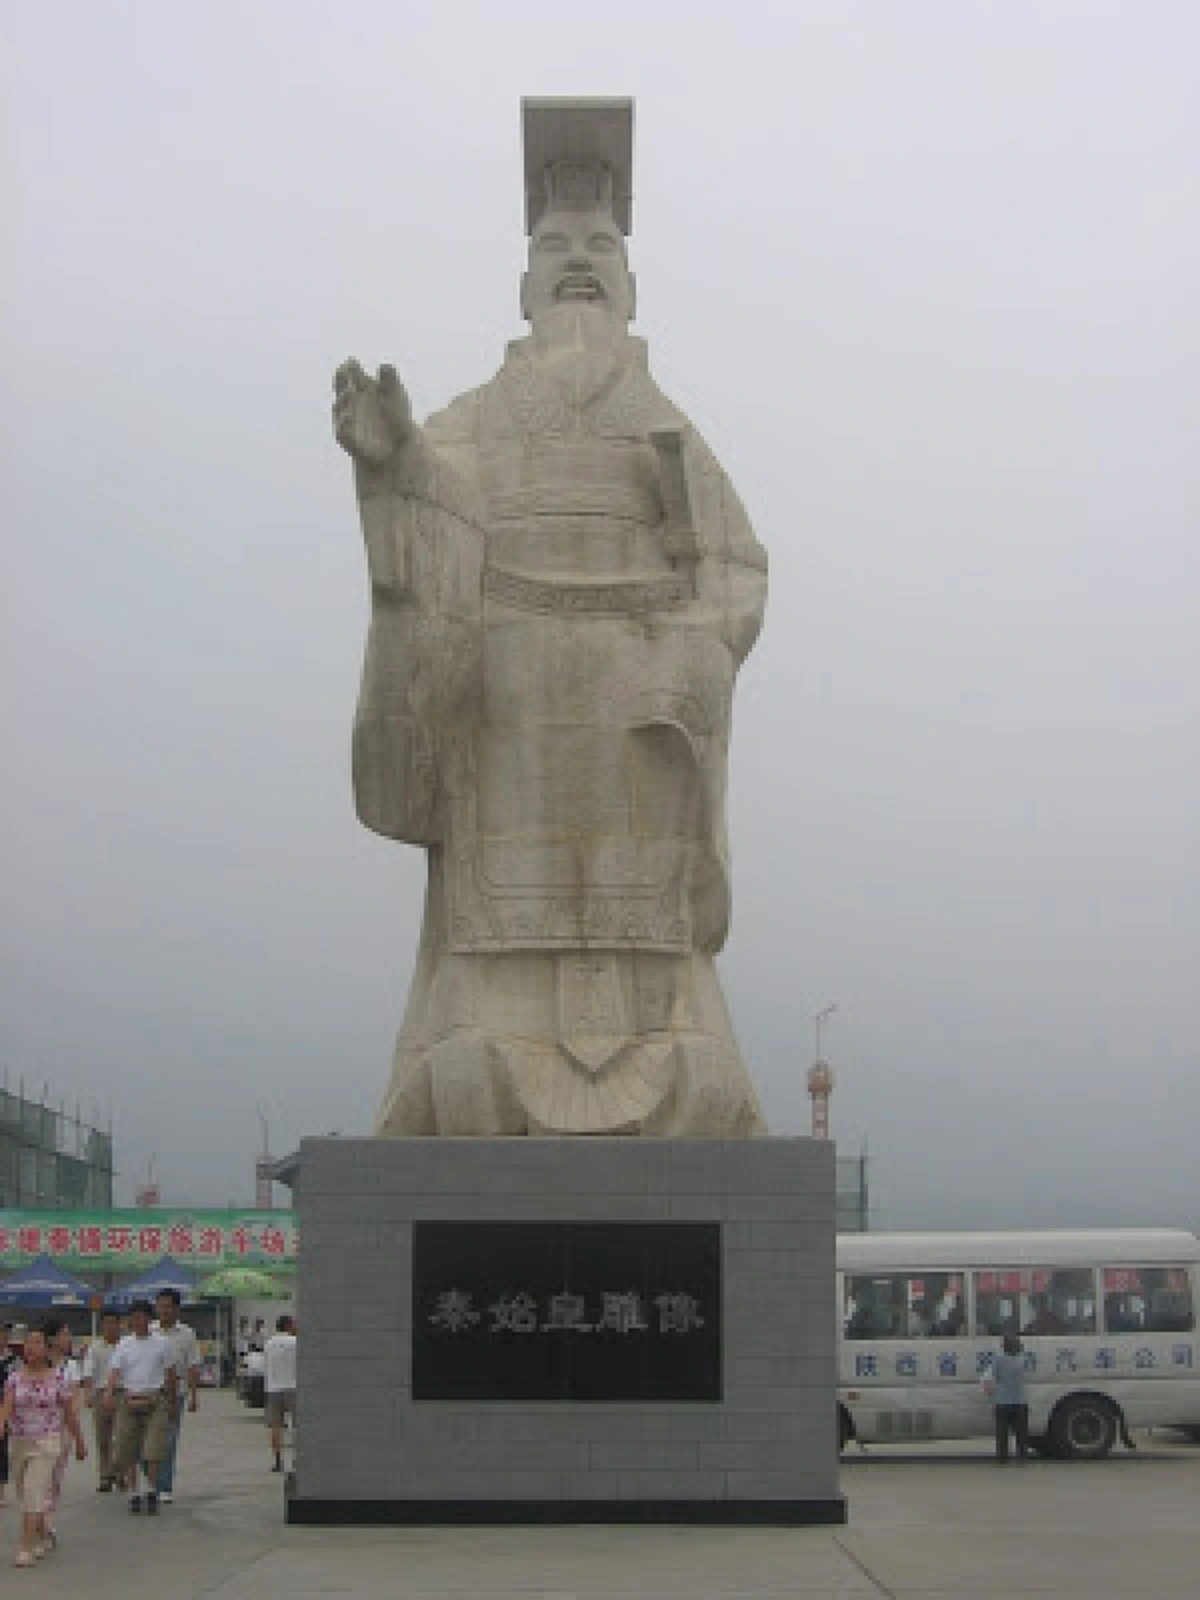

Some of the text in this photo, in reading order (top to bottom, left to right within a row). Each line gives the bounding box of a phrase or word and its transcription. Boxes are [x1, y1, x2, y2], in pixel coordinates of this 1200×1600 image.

[427, 1289, 705, 1334] 秦始皇雕像
